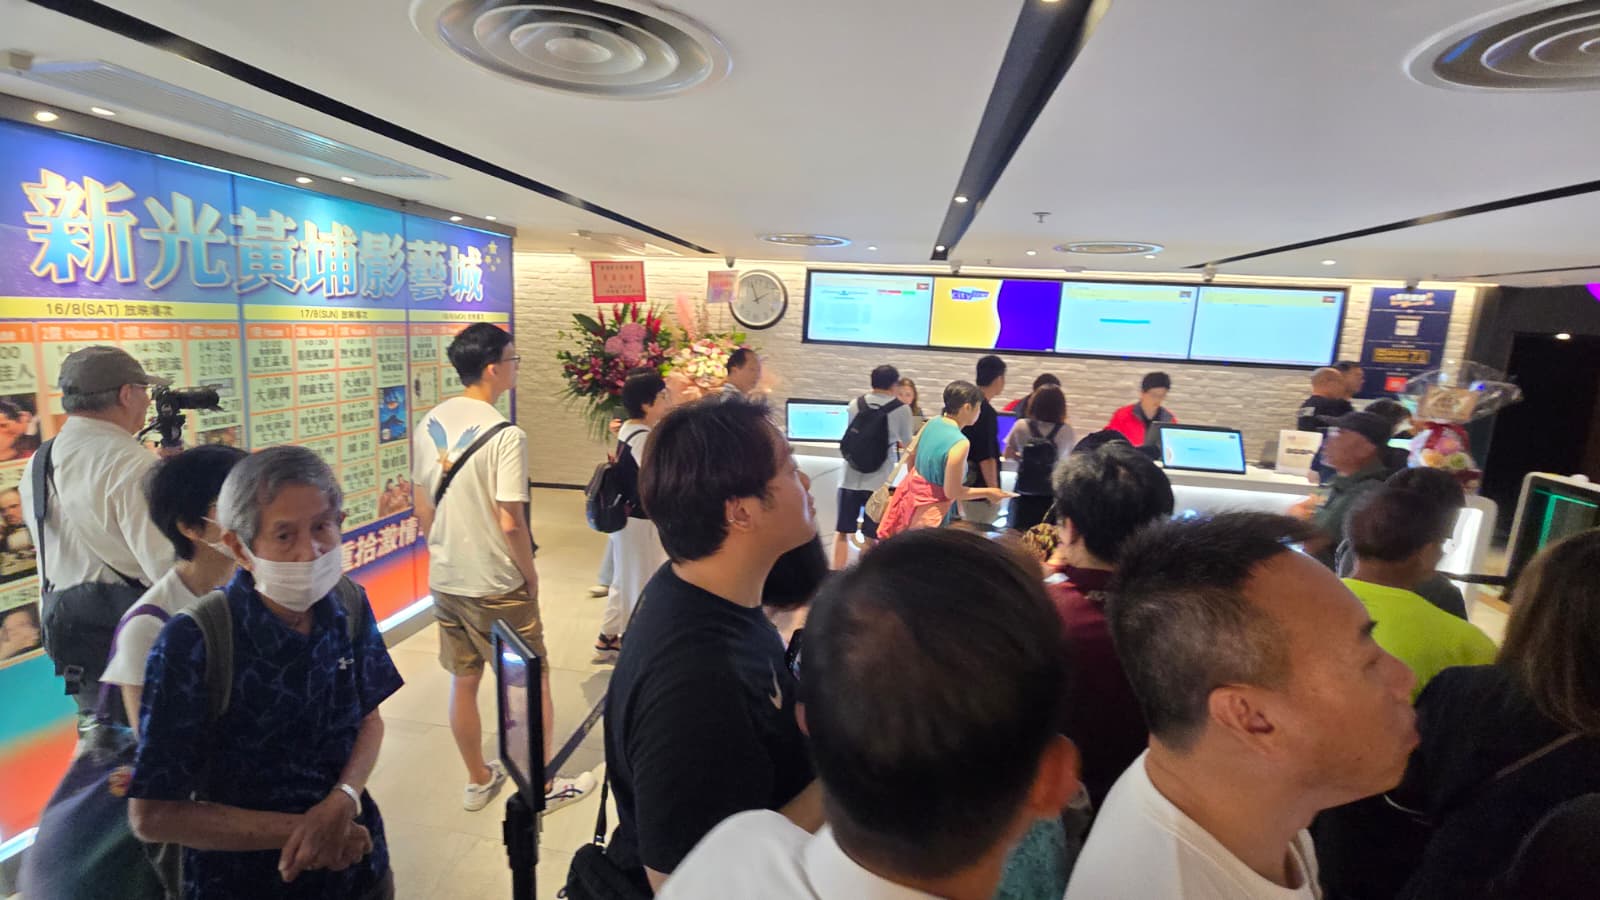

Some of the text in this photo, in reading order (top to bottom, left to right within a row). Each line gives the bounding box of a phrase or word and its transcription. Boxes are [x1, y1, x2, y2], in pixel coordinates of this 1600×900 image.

[21, 168, 484, 302] 新光黃埔影藝城
[47, 303, 120, 317] 16/8(SAT)
